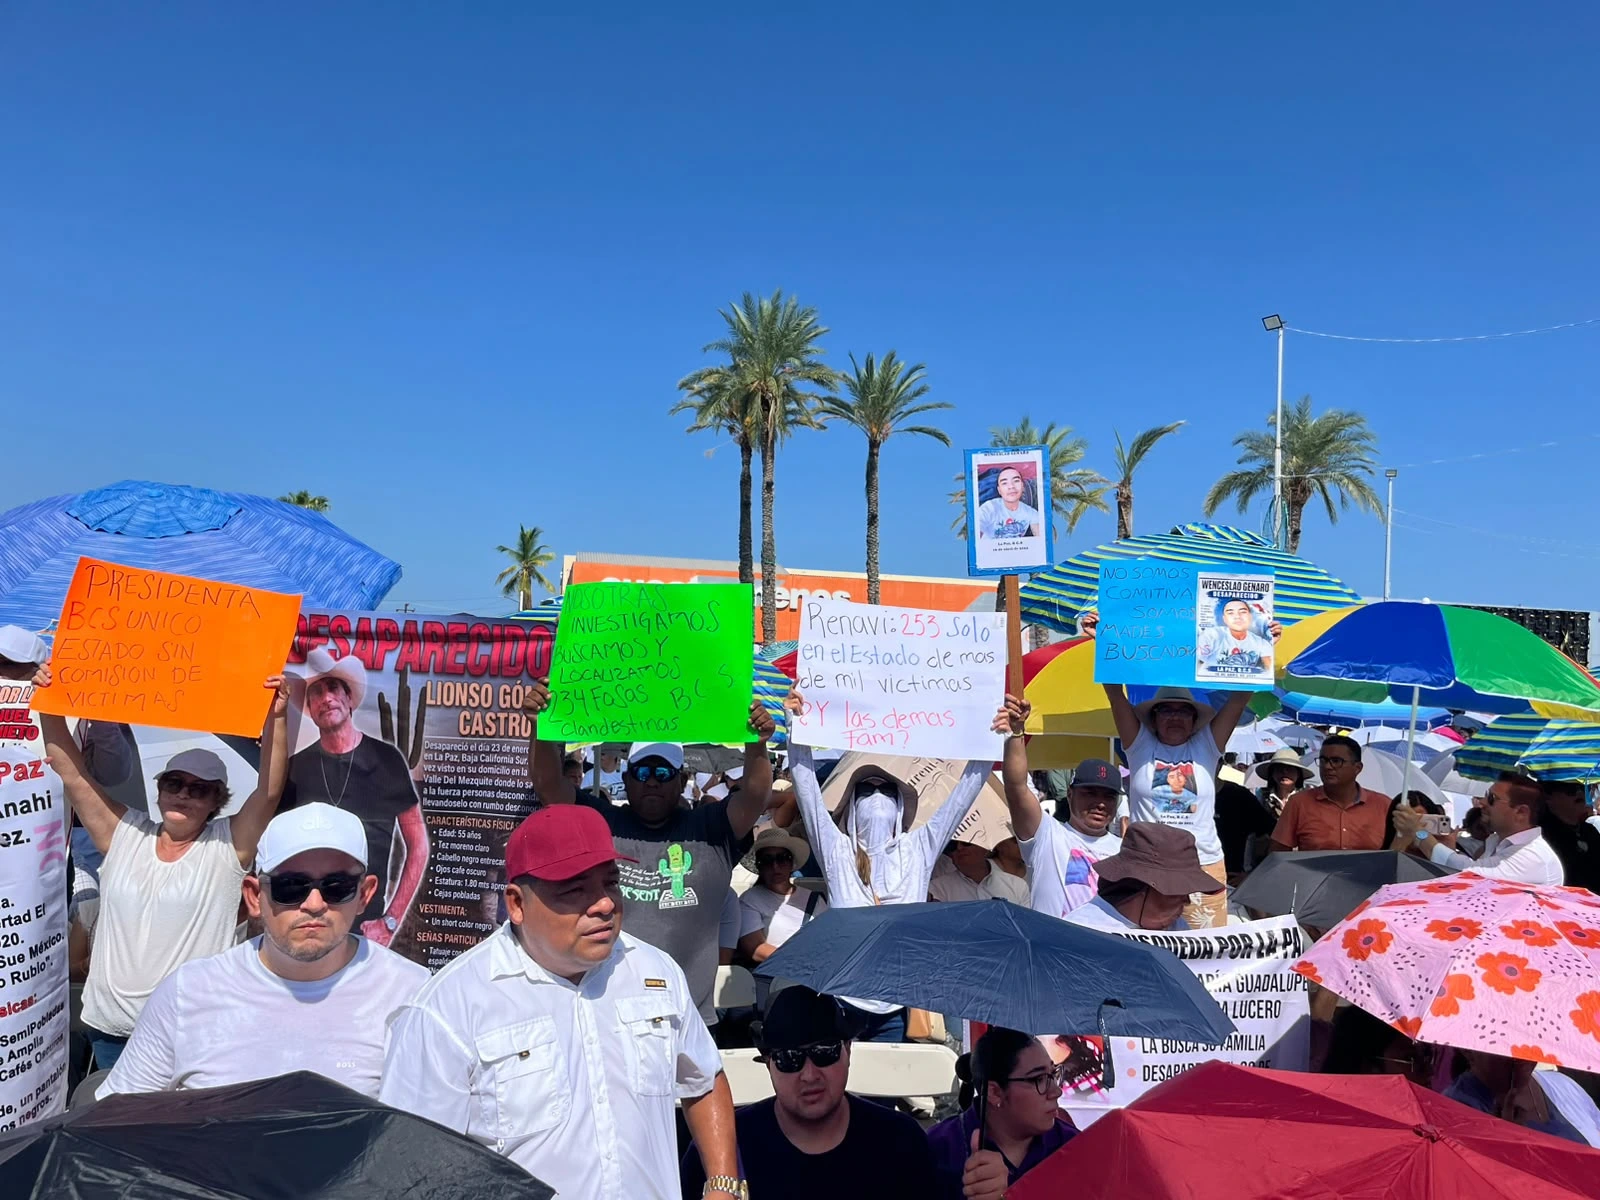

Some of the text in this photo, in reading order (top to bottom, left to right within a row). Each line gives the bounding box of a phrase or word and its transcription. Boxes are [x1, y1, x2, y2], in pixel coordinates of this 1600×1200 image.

[1104, 567, 1190, 579] NO SOMOS
[85, 564, 261, 618] PRESIDENTA
[1106, 586, 1194, 600] COMITIVA
[1202, 580, 1270, 592] WENCESLAO GENARO
[1212, 591, 1258, 599] DESAPARECIDO
[565, 584, 668, 613] NOSOTRAS
[66, 601, 202, 637] BCS UNICO
[571, 600, 721, 634] INVESTIGAMOS
[900, 613, 941, 639] 253
[56, 638, 194, 662] ESTADO SIN
[553, 636, 669, 667] BUSCAMOS Y
[802, 643, 995, 669] en el Estado de mas
[59, 664, 202, 686] COMISION DE
[560, 656, 681, 684] LOCALIZAMOS
[800, 668, 973, 694] de mil victimas
[66, 690, 185, 712] VICTIMAS
[426, 679, 533, 709] LIONSO GÓ
[548, 688, 590, 723] 234
[845, 700, 876, 729] las
[882, 708, 955, 729] demas
[424, 740, 468, 752] Desapareció
[470, 742, 477, 751] el
[478, 742, 490, 752] día
[491, 743, 501, 752] 23
[502, 743, 511, 753] de
[434, 753, 443, 761] La
[444, 754, 460, 763] Paz,
[461, 754, 478, 764] Baja
[479, 754, 514, 764] California
[437, 764, 455, 773] visto
[456, 766, 467, 774] en
[468, 766, 477, 774] su
[478, 765, 511, 776] domicilio
[511, 768, 521, 776] en
[521, 767, 528, 776] la
[423, 774, 442, 784] Valle
[443, 775, 456, 784] Del
[458, 776, 493, 789] Mezquite
[494, 778, 515, 788] donde
[516, 779, 524, 788] lo
[428, 787, 436, 795] la
[437, 787, 461, 797] fuerza
[462, 788, 495, 799] personas
[423, 798, 468, 809] llevandoselo
[469, 800, 482, 809] con
[482, 801, 504, 811] rumbo
[426, 814, 492, 829] CARACTERÍSTICAS
[438, 828, 482, 840] Edad: 55 años
[450, 843, 473, 852] moreno
[475, 843, 490, 853] claro
[436, 853, 460, 862] Cabello
[462, 855, 479, 865] negro
[435, 865, 451, 875] Ojos
[466, 868, 486, 877] oscuro
[435, 877, 463, 887] Estatura:
[464, 878, 478, 888] 1.80
[478, 880, 490, 889] mts
[434, 889, 481, 900] Cejas pobladas
[35, 902, 46, 919] El
[419, 903, 467, 916] VESTIMENTA:
[431, 918, 492, 931] Un short color negro
[417, 931, 442, 942] SEÑAS
[1217, 933, 1253, 960] POR
[1256, 931, 1280, 959] LA
[29, 932, 65, 960] México.
[1236, 973, 1308, 993] GUADALUPE
[1232, 999, 1281, 1019] LUCERO
[8, 1035, 44, 1063] Amplia
[1142, 1036, 1157, 1054] LA
[1162, 1038, 1199, 1054] BUSCA
[0, 1060, 33, 1082] Cafés
[20, 1093, 33, 1108] un
[18, 1095, 53, 1126] negros.
